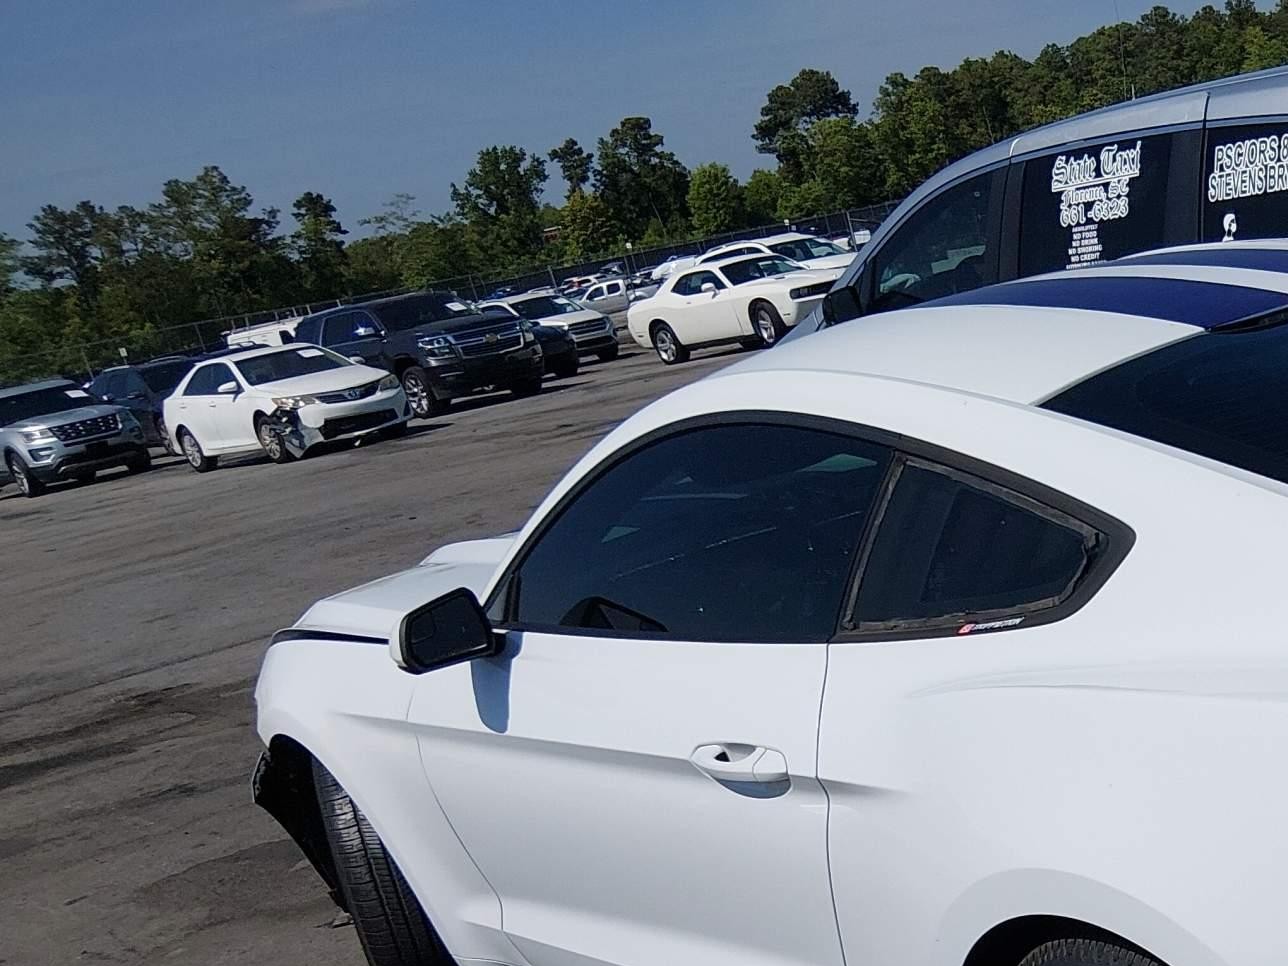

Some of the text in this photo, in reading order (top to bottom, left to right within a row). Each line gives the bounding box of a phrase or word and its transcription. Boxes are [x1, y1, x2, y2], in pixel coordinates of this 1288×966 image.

[1052, 140, 1141, 187] State Taxi
[1214, 135, 1279, 173] PSC/ORS
[1208, 166, 1266, 202] STEVENS
